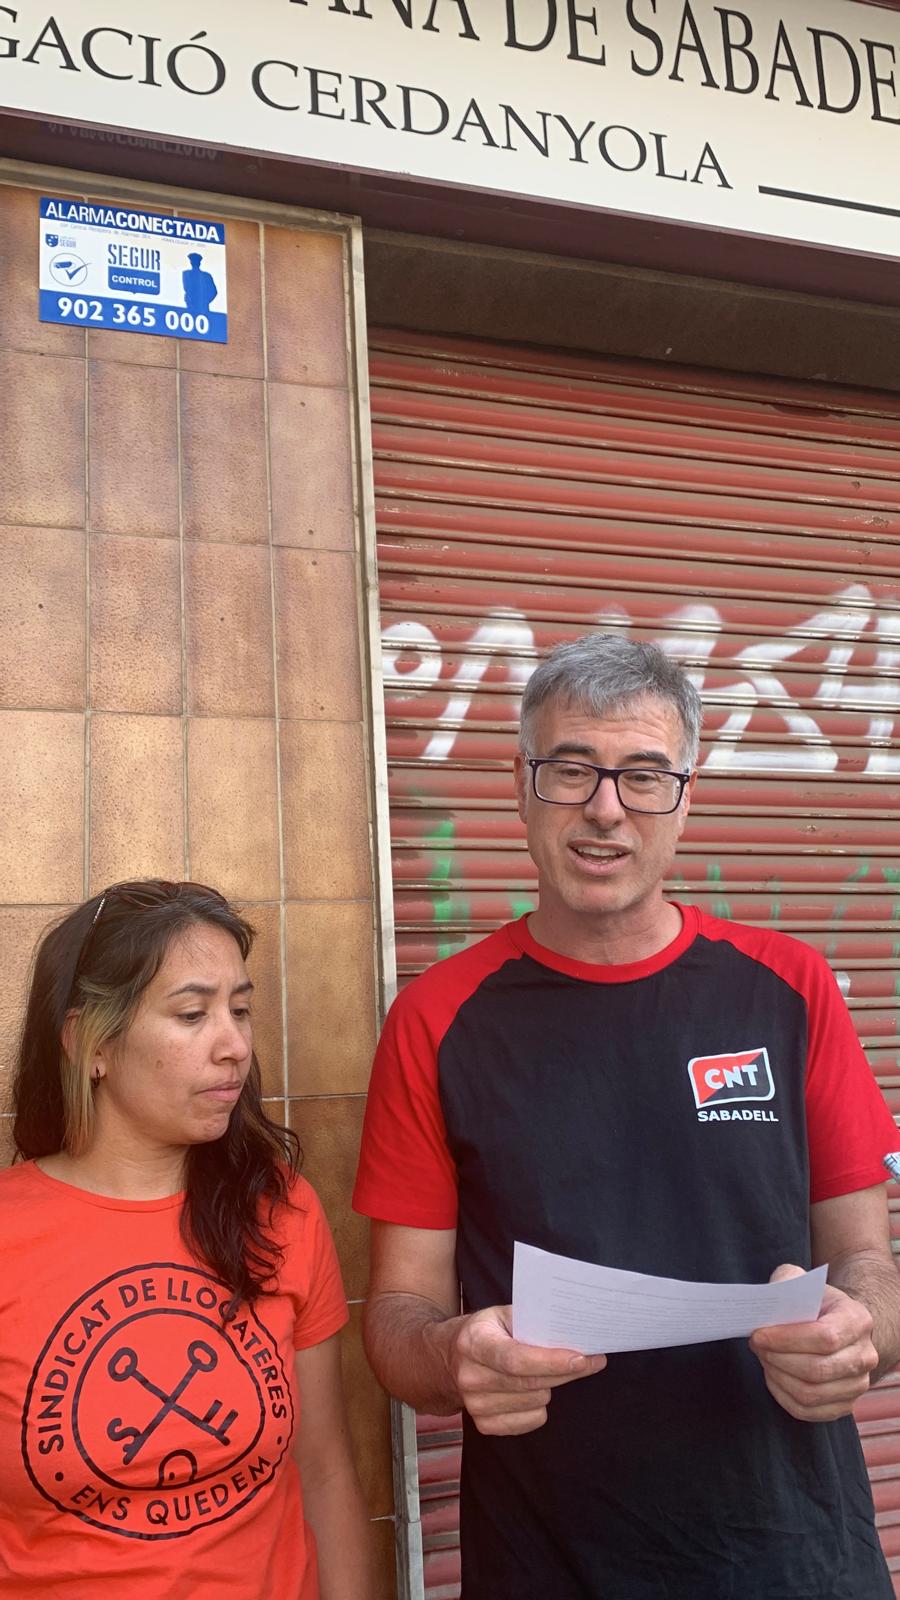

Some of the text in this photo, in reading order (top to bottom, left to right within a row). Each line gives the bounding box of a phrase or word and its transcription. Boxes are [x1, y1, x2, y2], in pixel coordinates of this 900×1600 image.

[251, 60, 734, 190] CERDANYOLA
[45, 201, 220, 242] ALARMACONECTADA
[107, 243, 161, 271] SEGUR
[111, 275, 158, 288] CONTROL
[57, 297, 210, 335] 902 365 000
[704, 1064, 758, 1090] CNT
[697, 1109, 779, 1122] SABADELL
[37, 1298, 112, 1456] SINDICAT
[118, 1277, 157, 1309] DE
[69, 1455, 272, 1526] ENS QUEDEM
